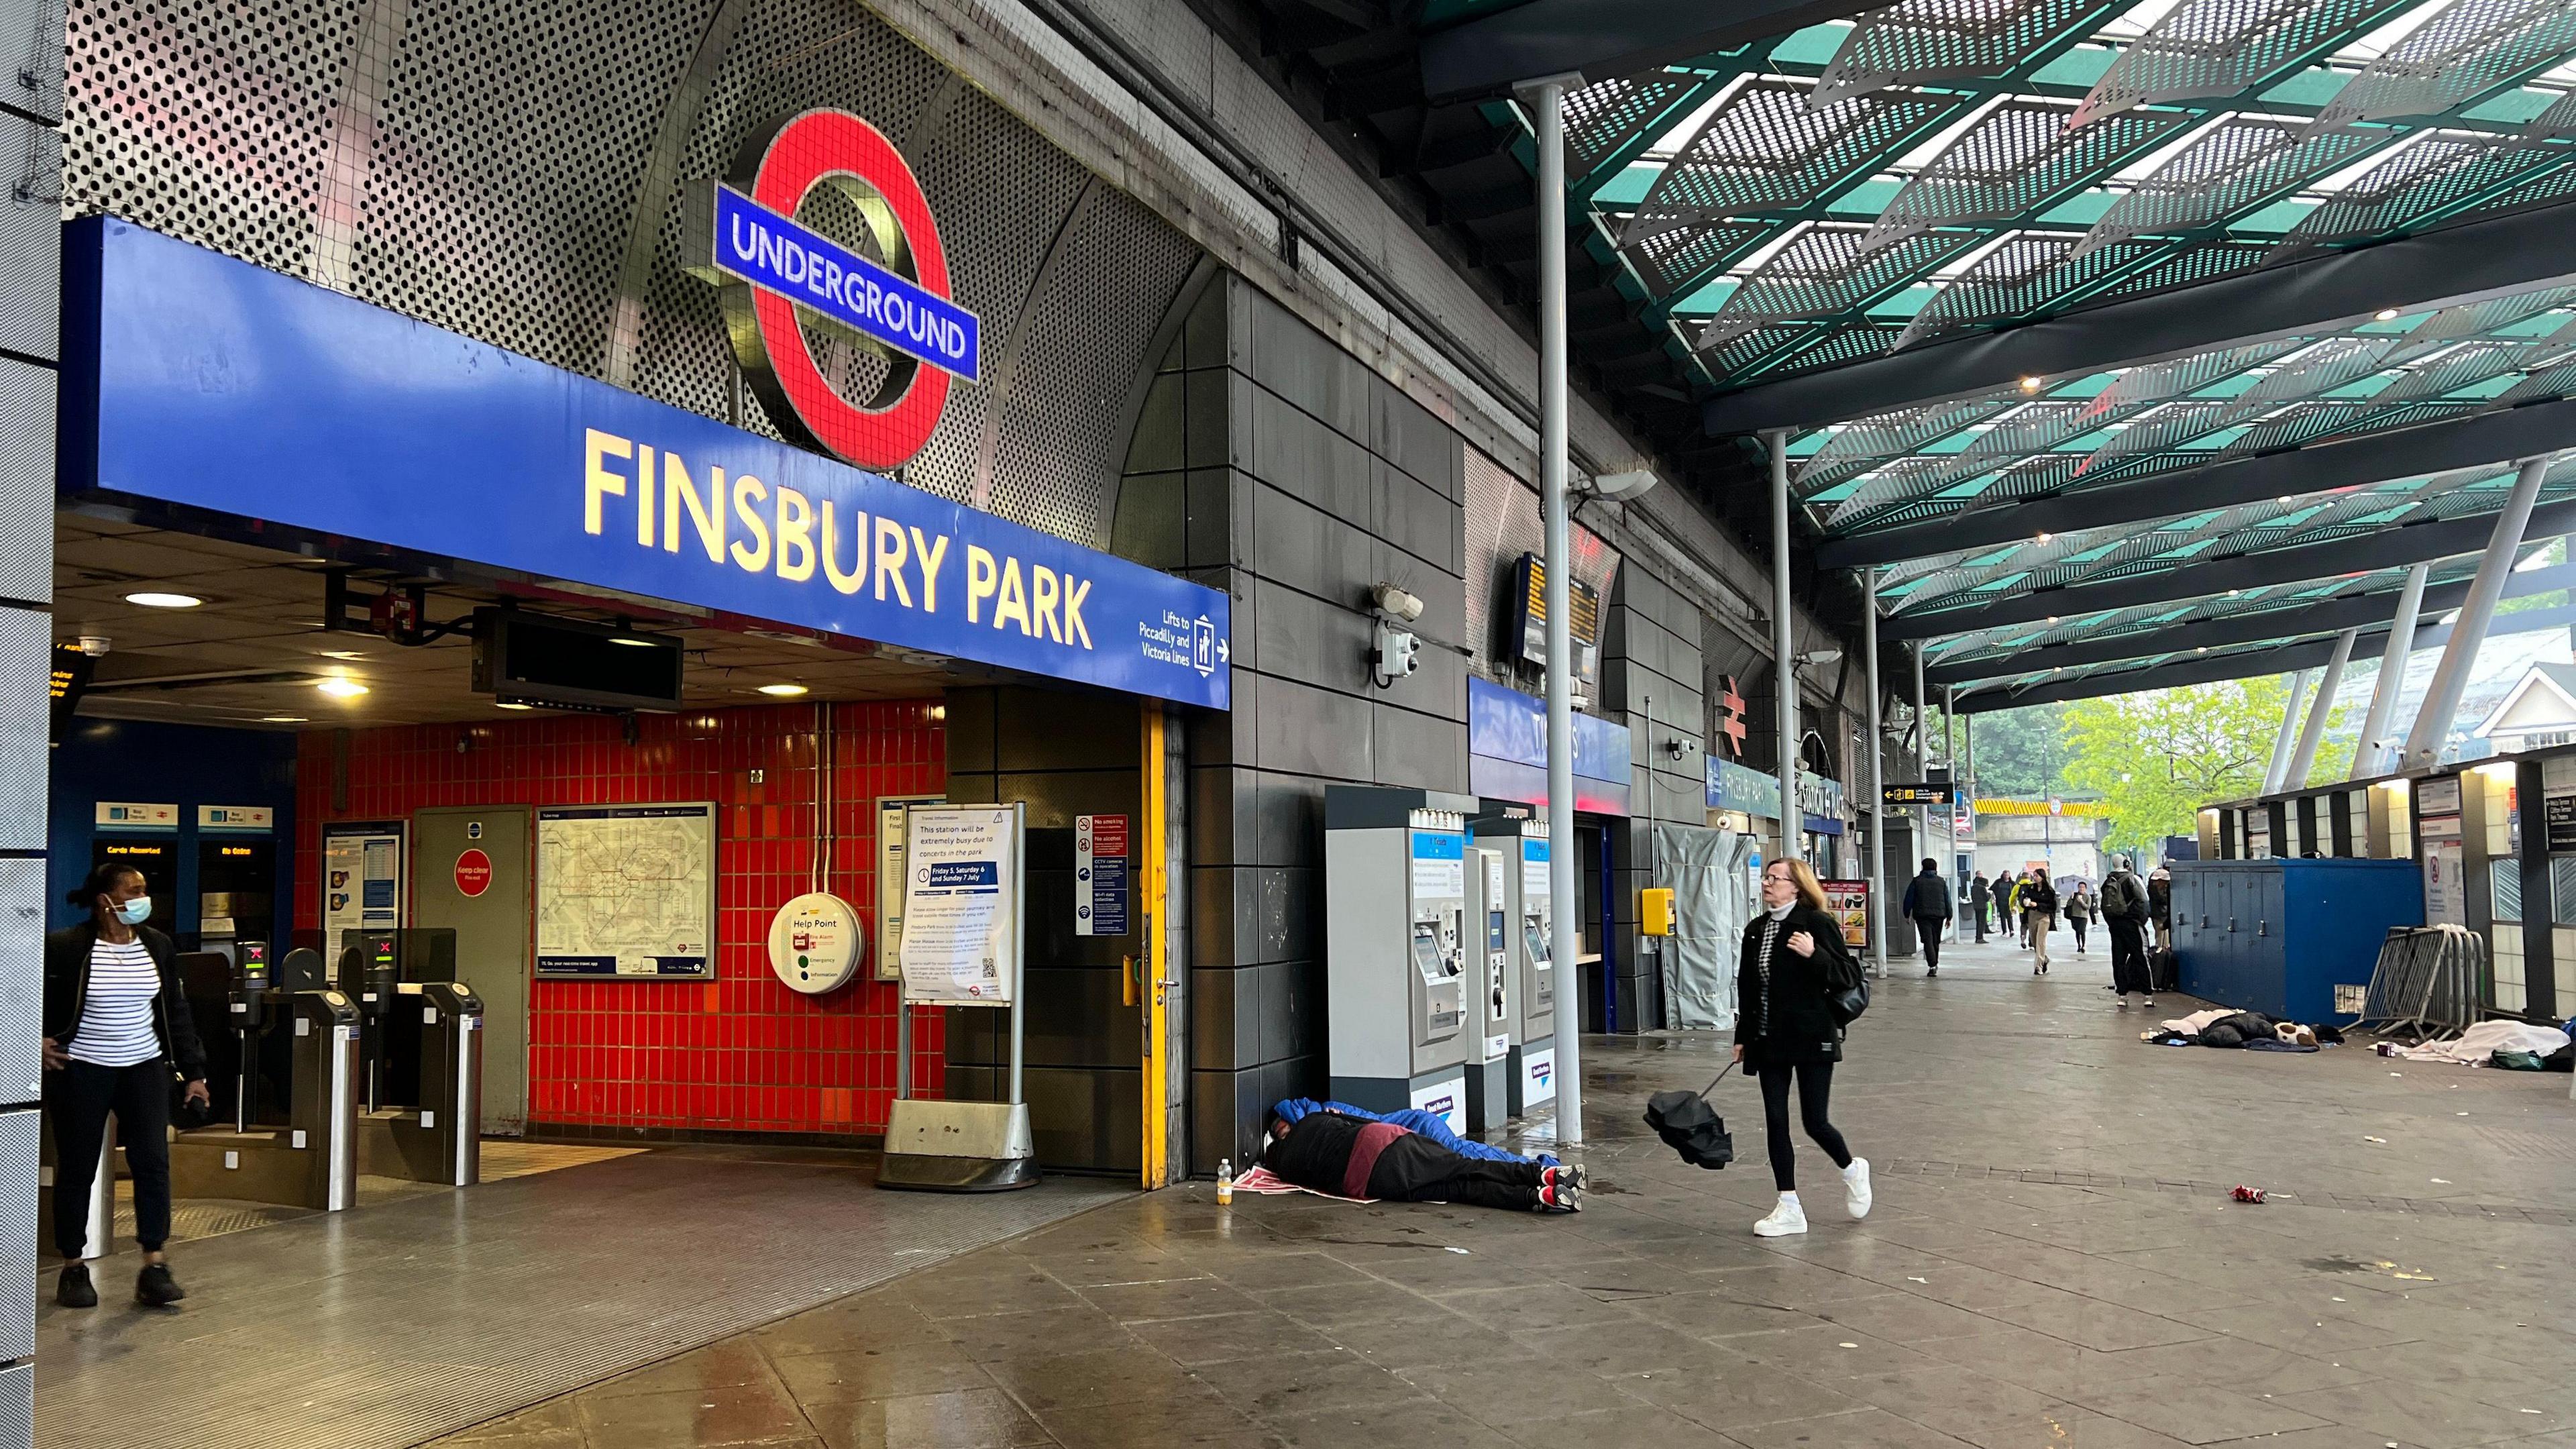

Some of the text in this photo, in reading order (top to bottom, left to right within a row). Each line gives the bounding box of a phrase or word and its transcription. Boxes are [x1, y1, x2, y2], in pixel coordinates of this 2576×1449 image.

[732, 212, 966, 360] UNDERGROUND
[584, 427, 1093, 649] FINSBURY PARK
[1163, 609, 1190, 630] Lifts to
[1139, 621, 1190, 649] Piccadilly and
[1142, 641, 1190, 667] Victoria lines
[458, 866, 472, 874] Keep
[794, 920, 812, 929] Help
